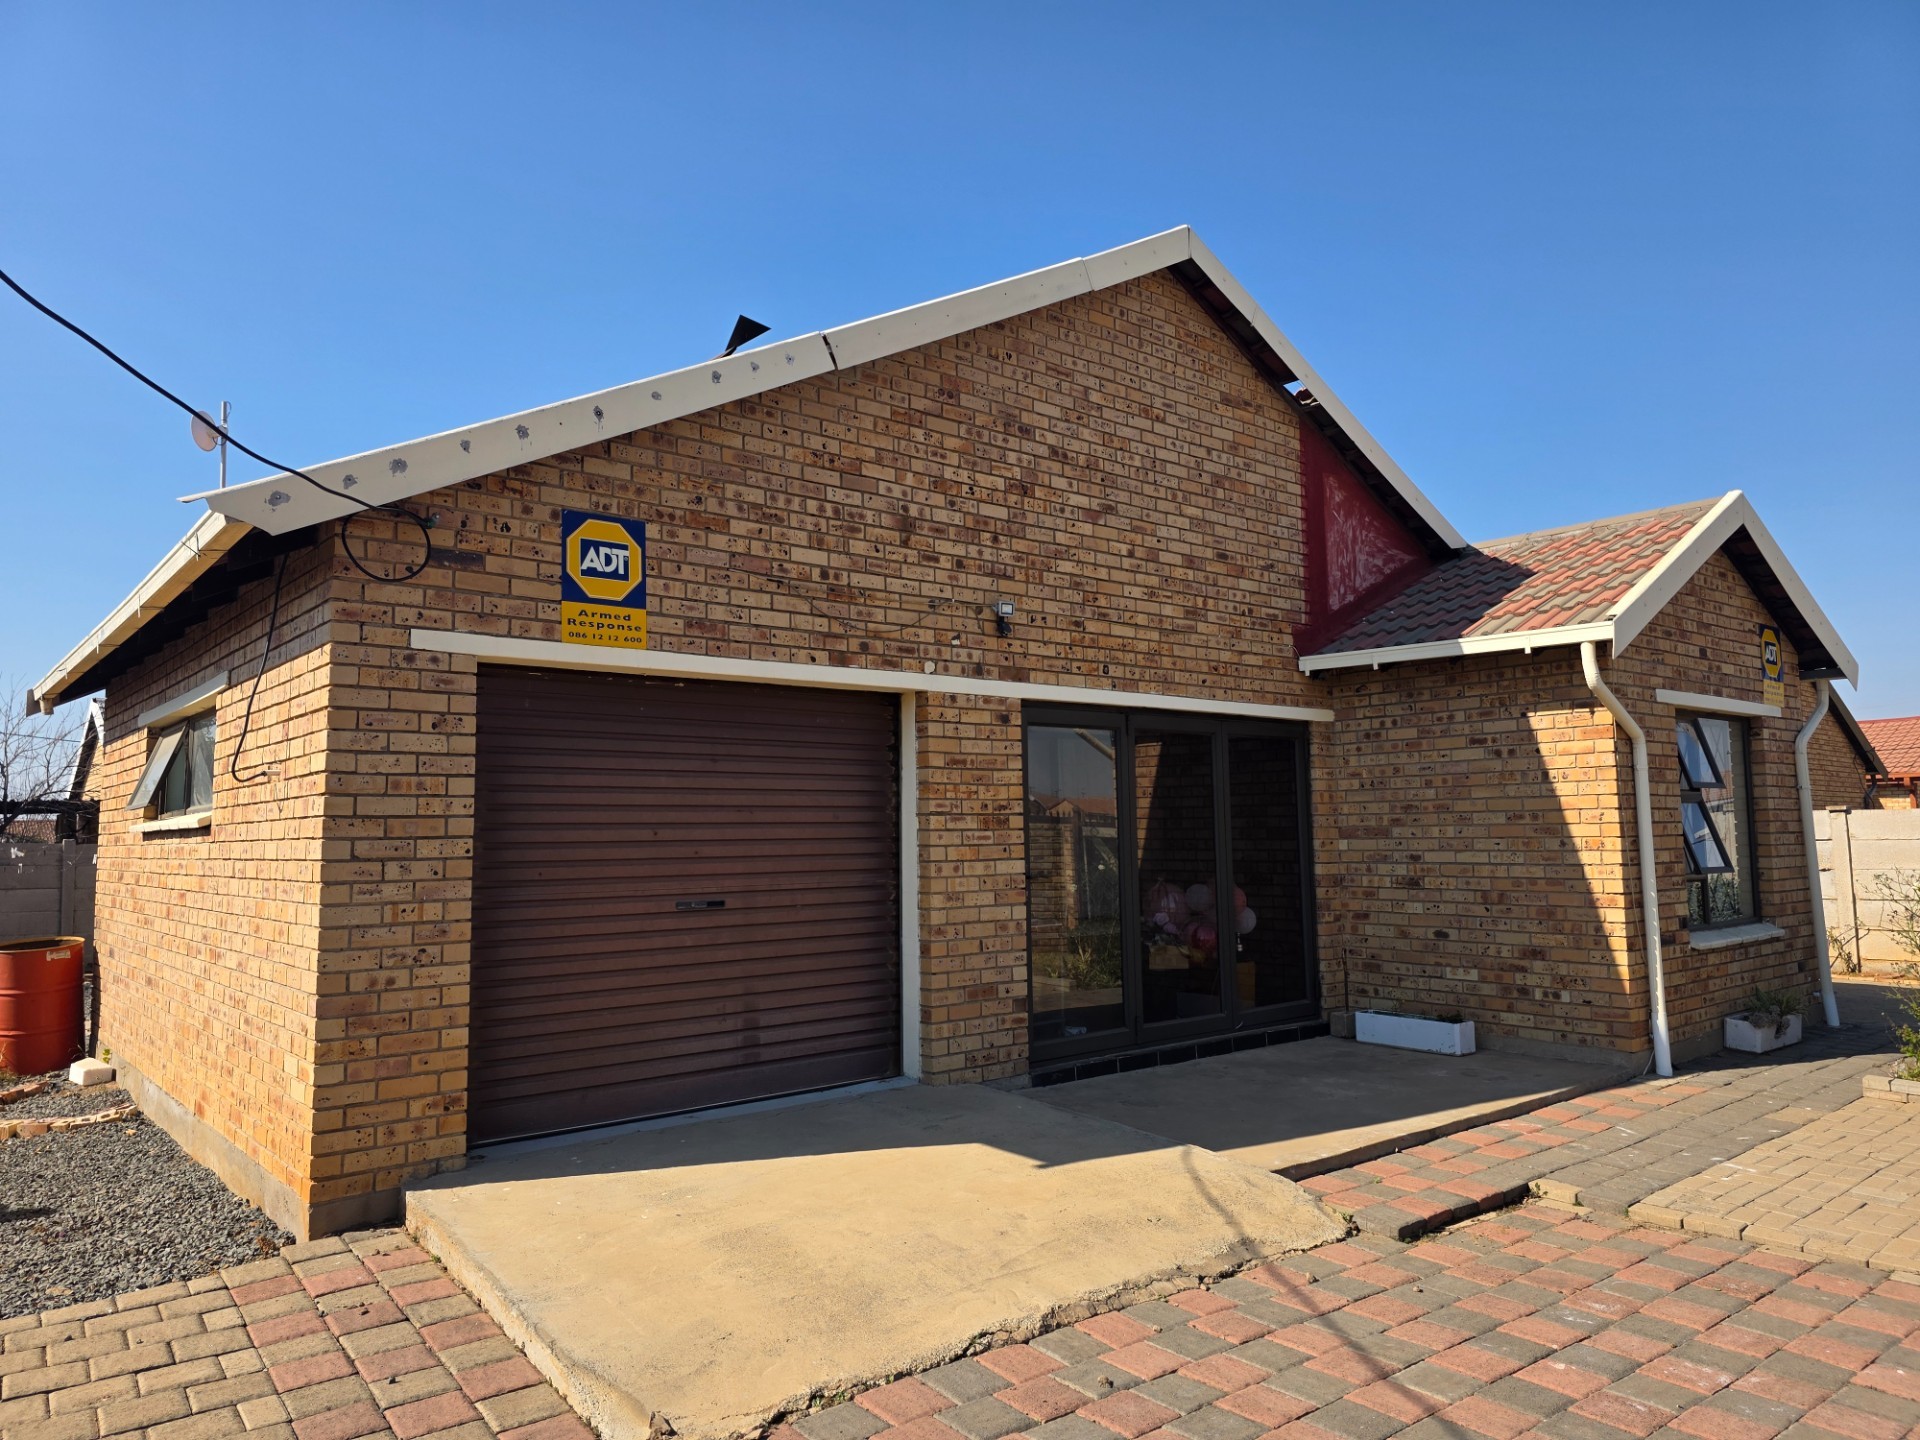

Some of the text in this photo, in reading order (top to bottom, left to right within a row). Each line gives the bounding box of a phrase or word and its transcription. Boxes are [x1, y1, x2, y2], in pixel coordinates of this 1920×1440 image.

[580, 546, 629, 574] ADT
[578, 609, 631, 621] Armed
[567, 618, 642, 632] Response
[568, 631, 588, 639] 086
